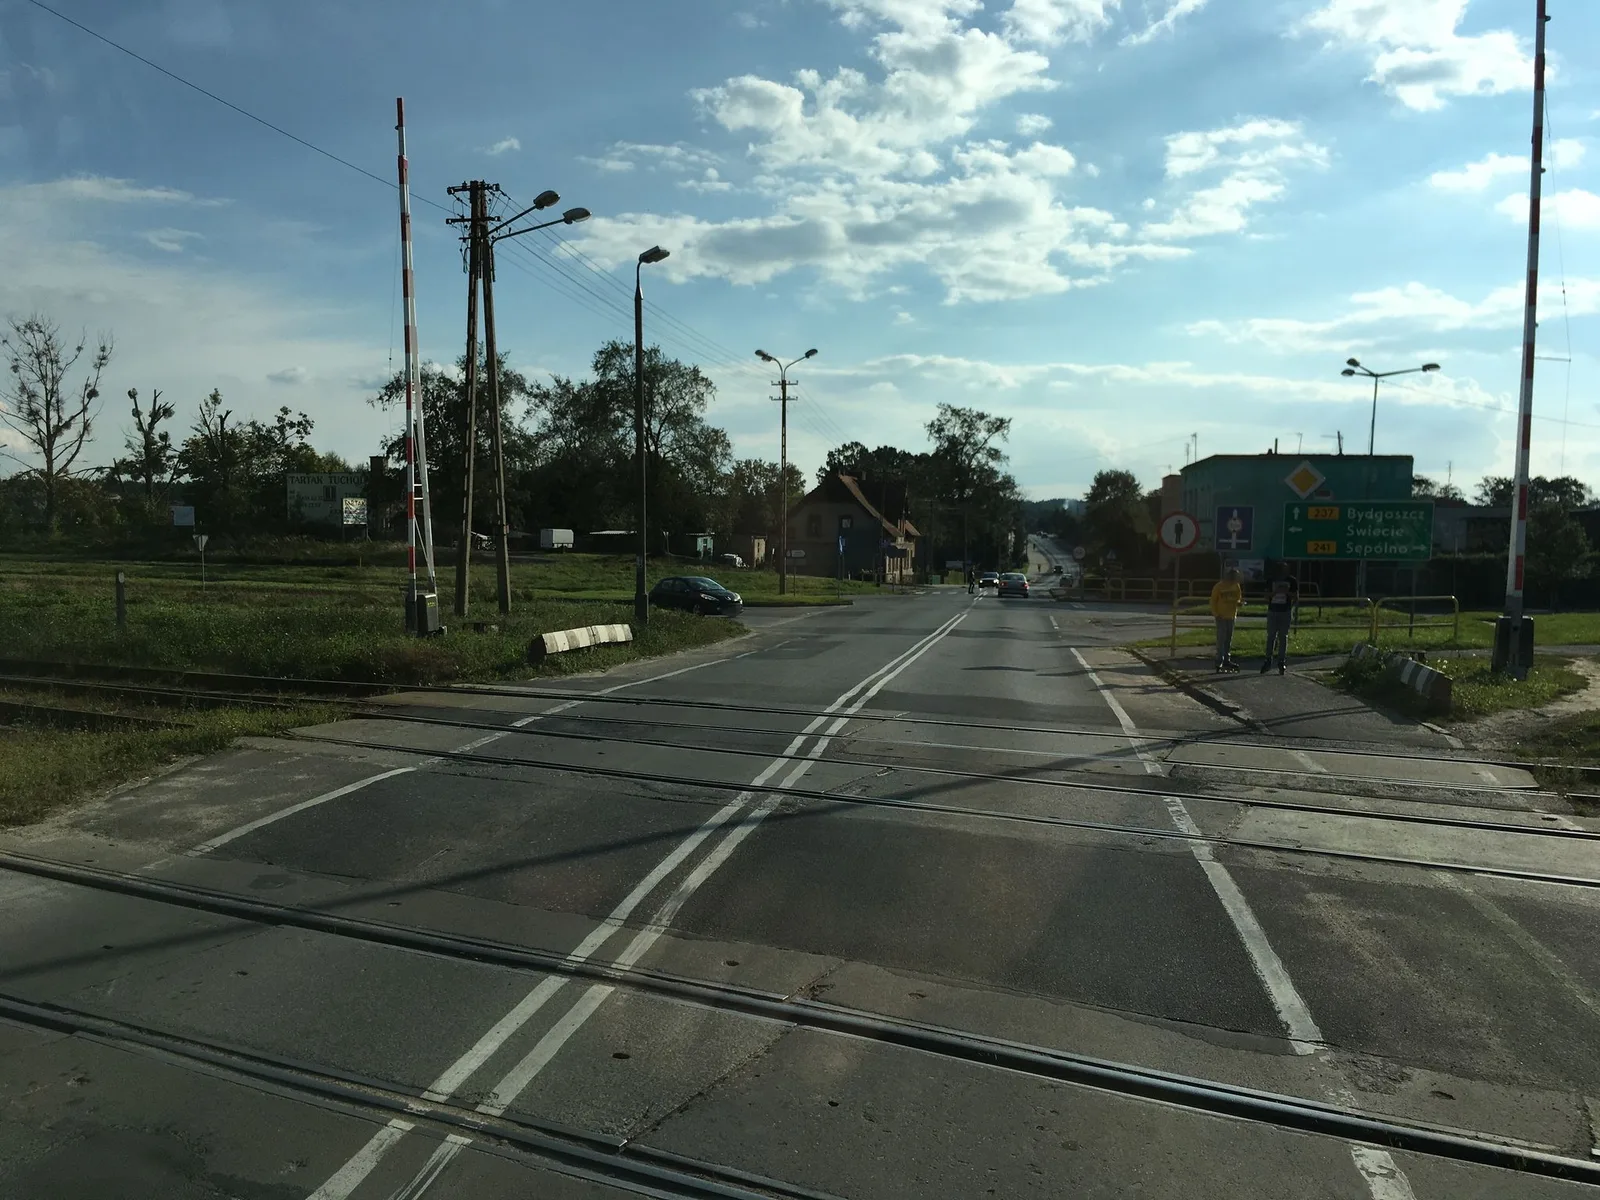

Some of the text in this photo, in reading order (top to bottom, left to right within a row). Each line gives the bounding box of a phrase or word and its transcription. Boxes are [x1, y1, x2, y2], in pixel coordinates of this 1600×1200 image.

[289, 475, 365, 485] TARTAK TUCHOL
[1347, 507, 1425, 523] Bydgoszcz
[1346, 524, 1405, 537] Świecie
[1313, 542, 1331, 552] 241
[1345, 541, 1408, 557] Sępólno
